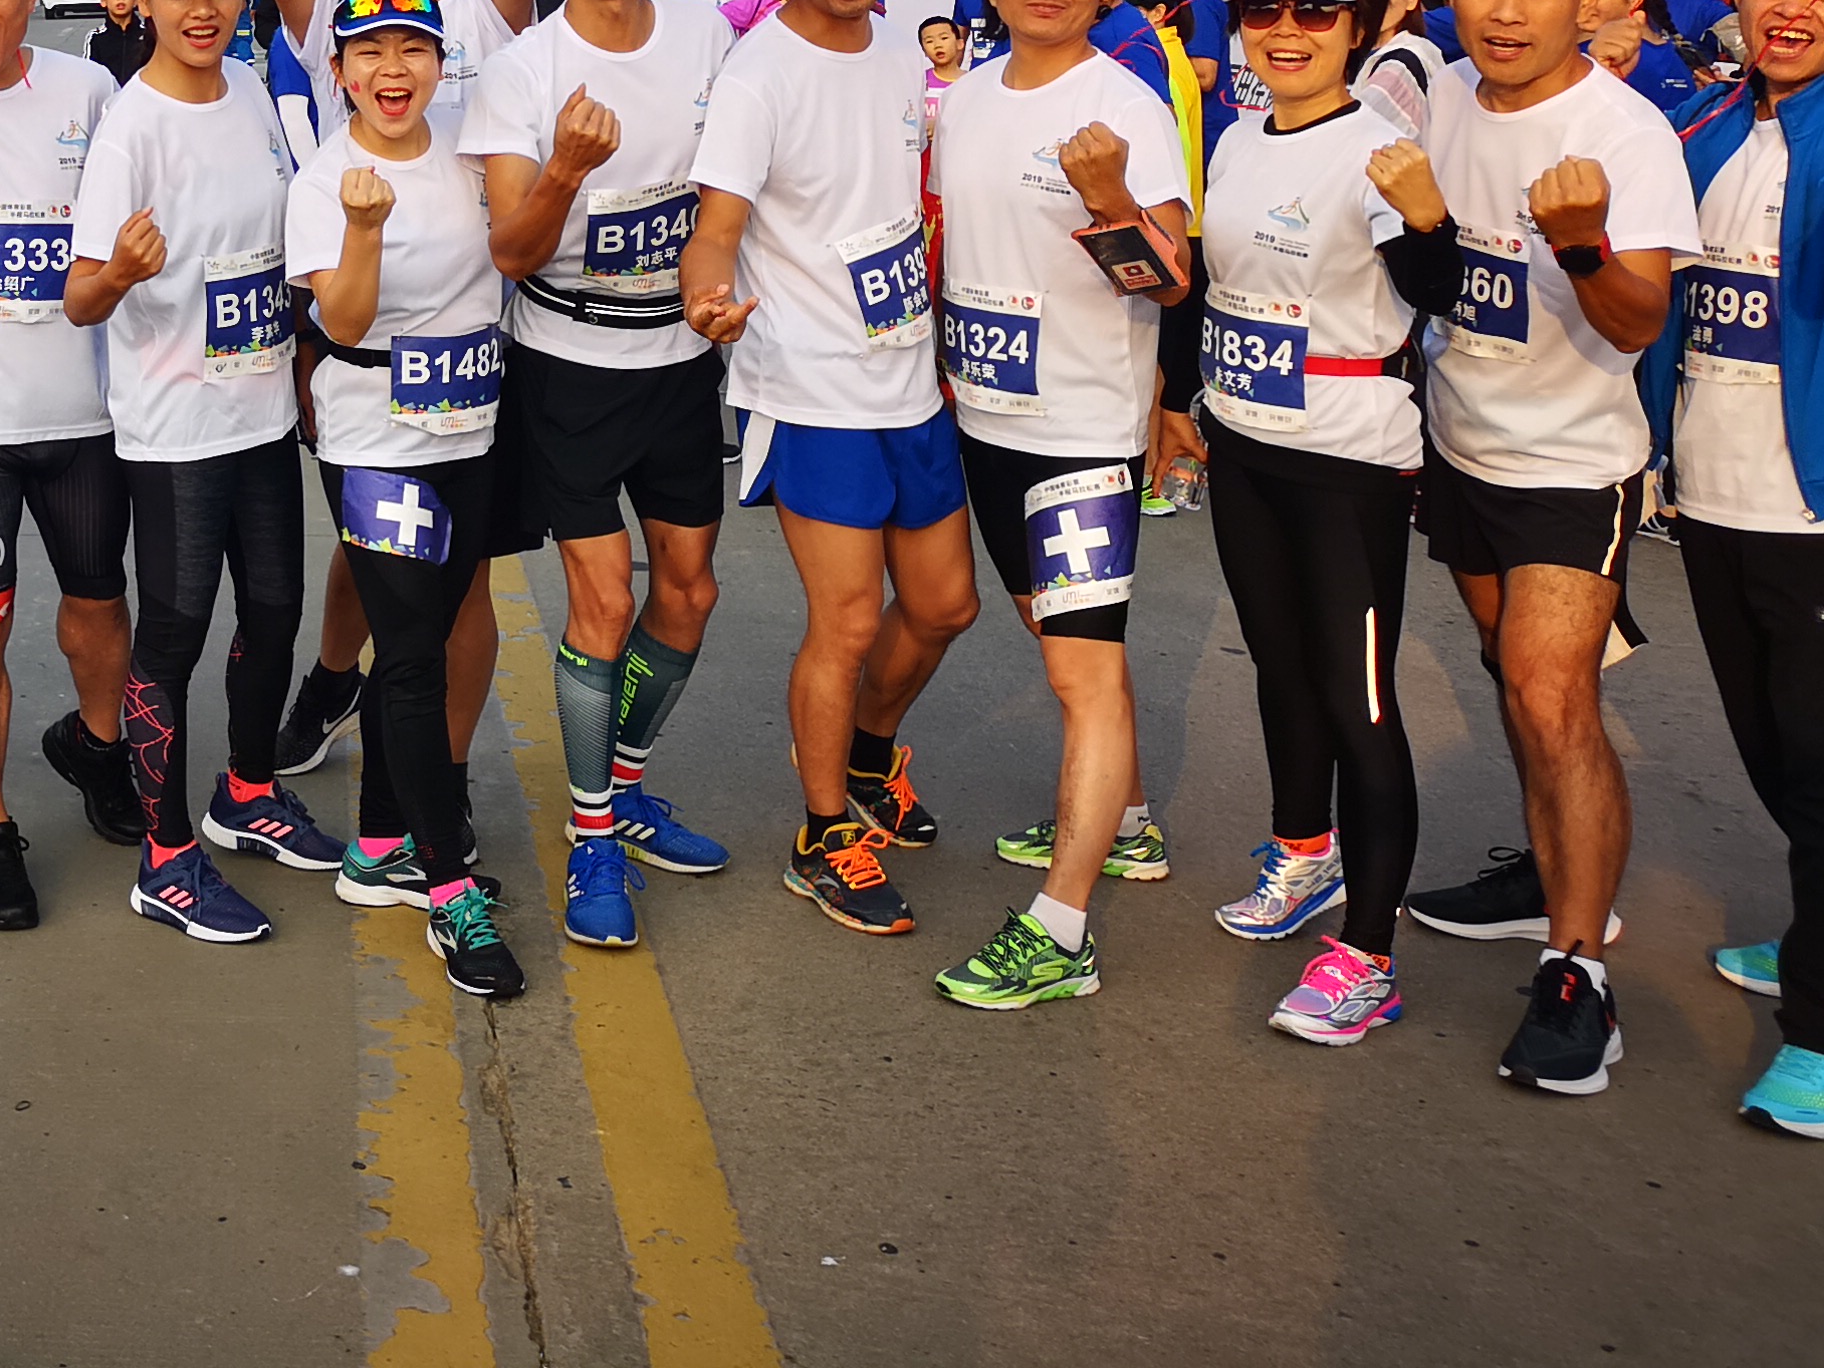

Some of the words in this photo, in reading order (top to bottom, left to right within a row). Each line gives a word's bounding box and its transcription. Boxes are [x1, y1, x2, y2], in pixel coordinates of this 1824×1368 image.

[860, 242, 927, 306] B139
[401, 338, 501, 384] B1482
[944, 313, 1030, 365] B1324
[1202, 316, 1294, 376] B1834
